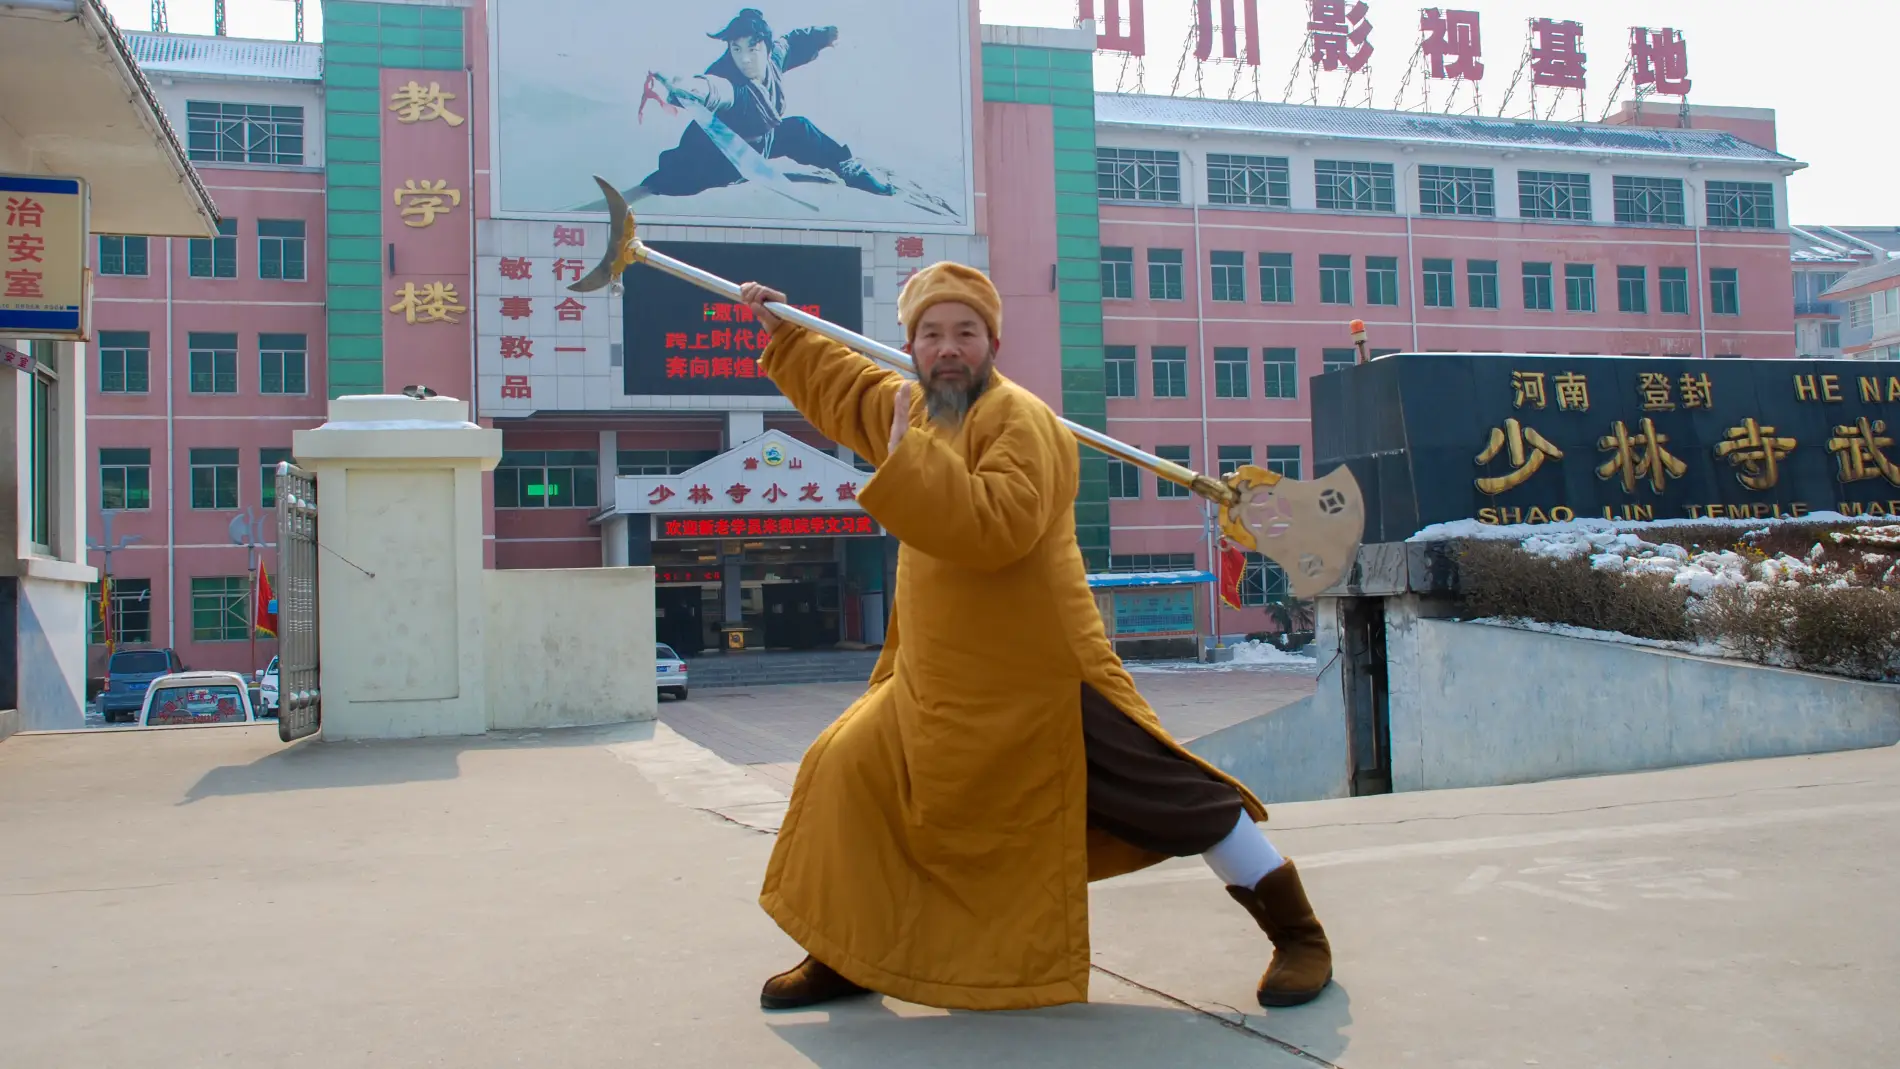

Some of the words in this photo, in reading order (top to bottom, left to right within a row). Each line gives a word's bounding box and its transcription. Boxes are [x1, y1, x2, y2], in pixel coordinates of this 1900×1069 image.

[388, 80, 466, 325] 教学楼
[4, 196, 45, 298] 治安室
[499, 256, 533, 398] 敏事敦品
[553, 225, 586, 352] 知行合一
[1511, 370, 1590, 411] 河南
[1637, 371, 1712, 411] 登封
[1793, 375, 1843, 402] HE
[648, 481, 857, 505] 少林寺小龙武
[1474, 416, 1900, 494] 少林寺武
[1479, 504, 1575, 525] SHAO
[1603, 504, 1653, 522] LIN
